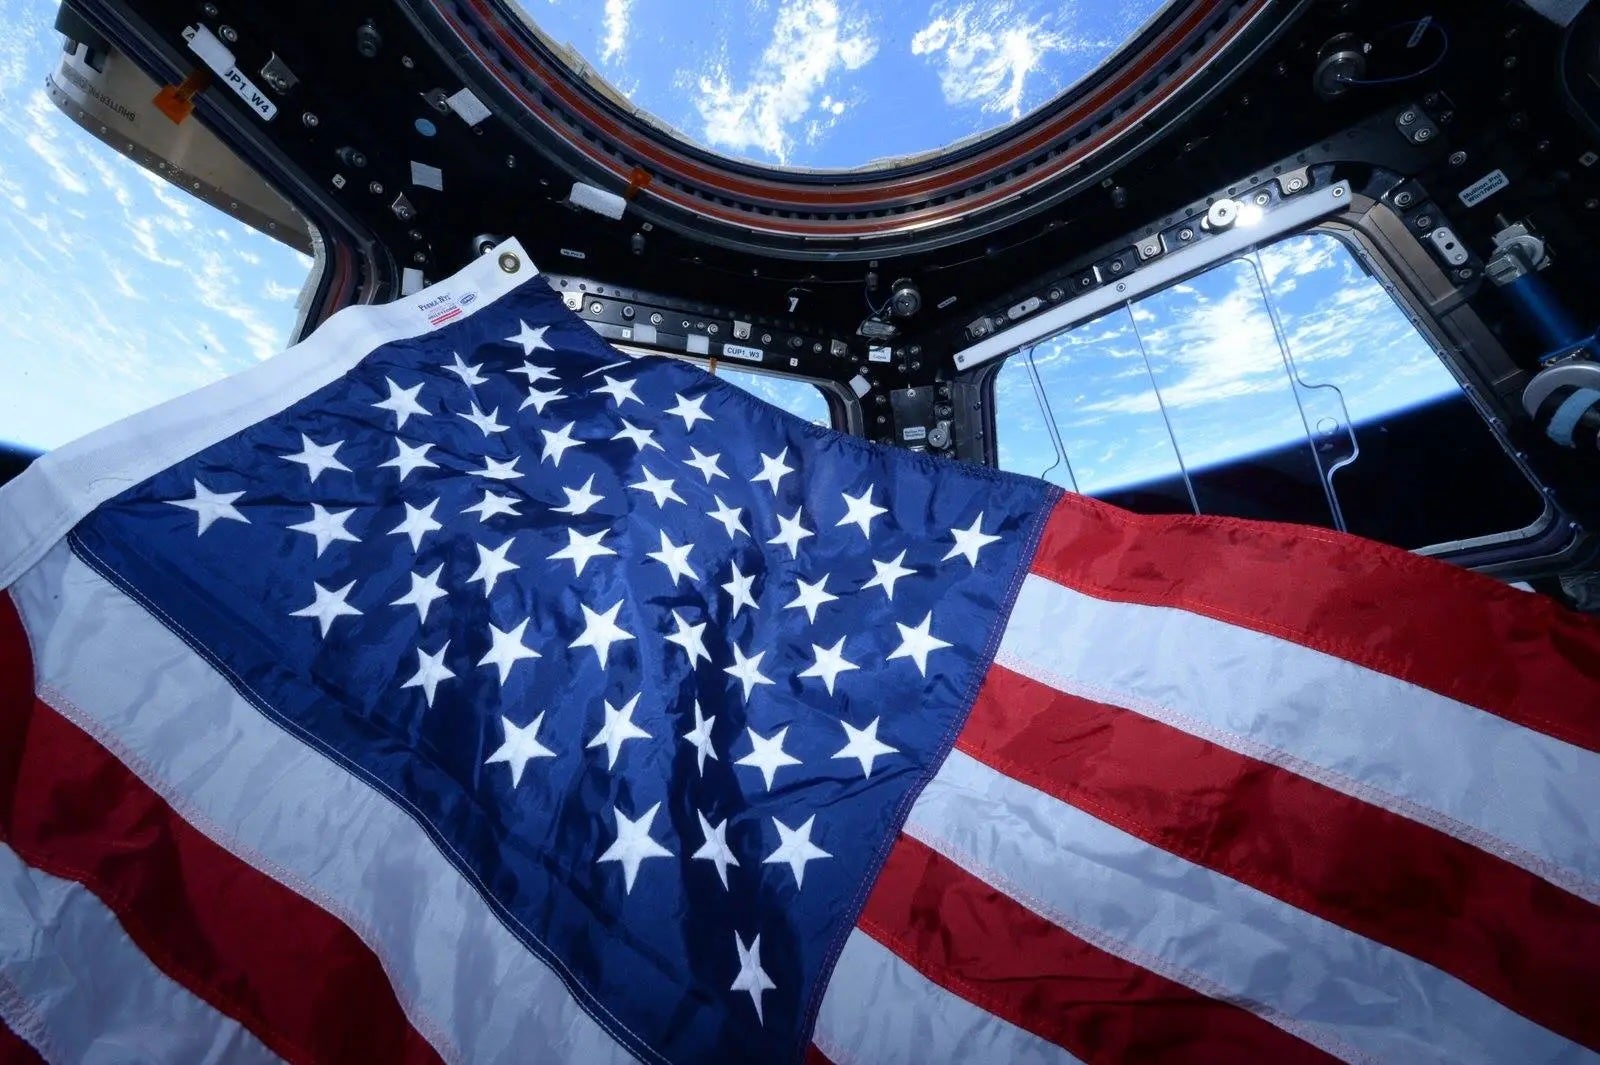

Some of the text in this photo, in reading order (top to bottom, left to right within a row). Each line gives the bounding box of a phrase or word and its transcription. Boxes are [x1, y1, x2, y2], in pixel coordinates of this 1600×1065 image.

[224, 69, 270, 113] JP1_W4
[99, 95, 136, 122] SHUTTER
[726, 347, 760, 358] CUP1_W3
